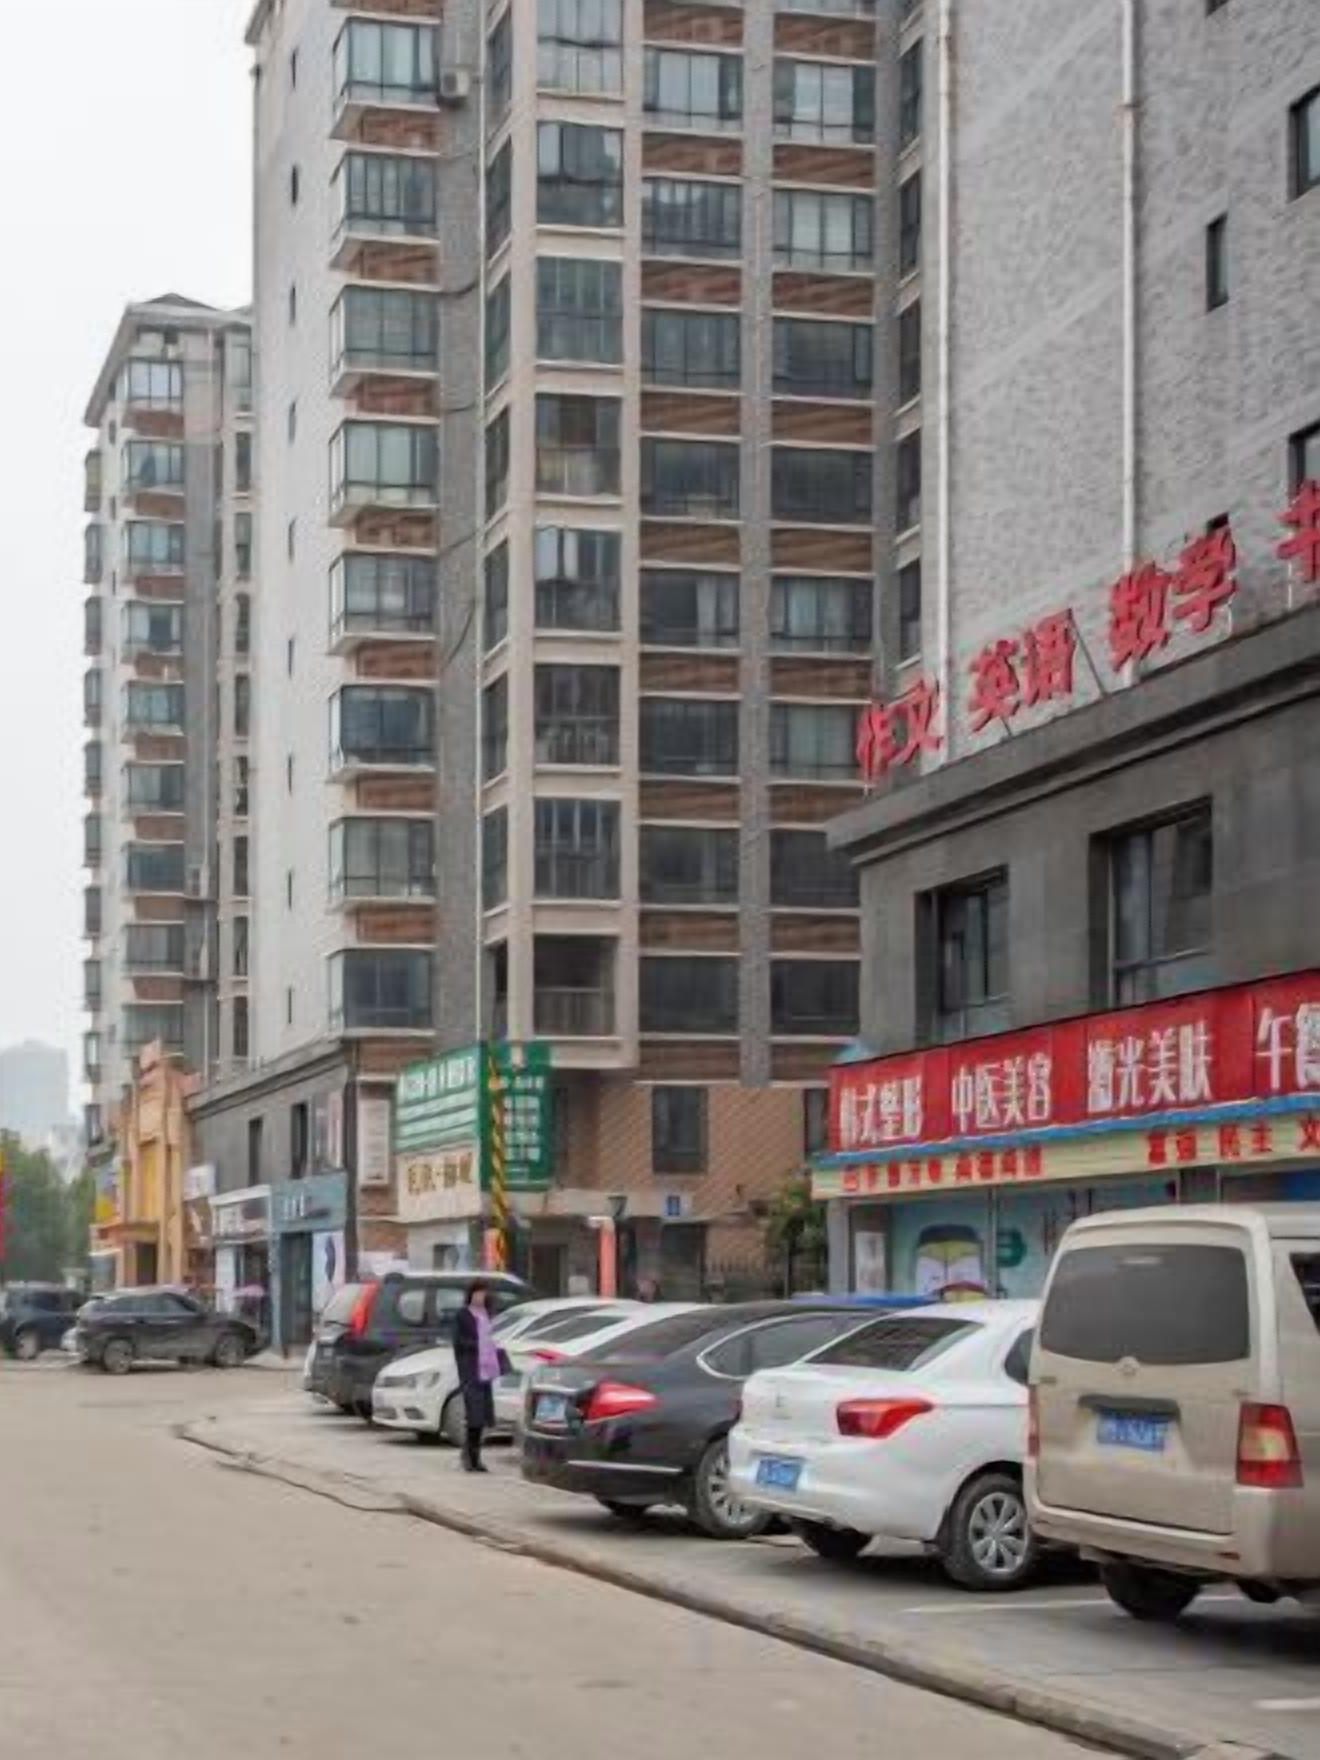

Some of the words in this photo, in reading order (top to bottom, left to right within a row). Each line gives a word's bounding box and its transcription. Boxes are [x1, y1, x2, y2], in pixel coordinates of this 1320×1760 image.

[857, 678, 944, 784] 作文
[968, 608, 1076, 731] 英语
[1109, 528, 1236, 672] 数学
